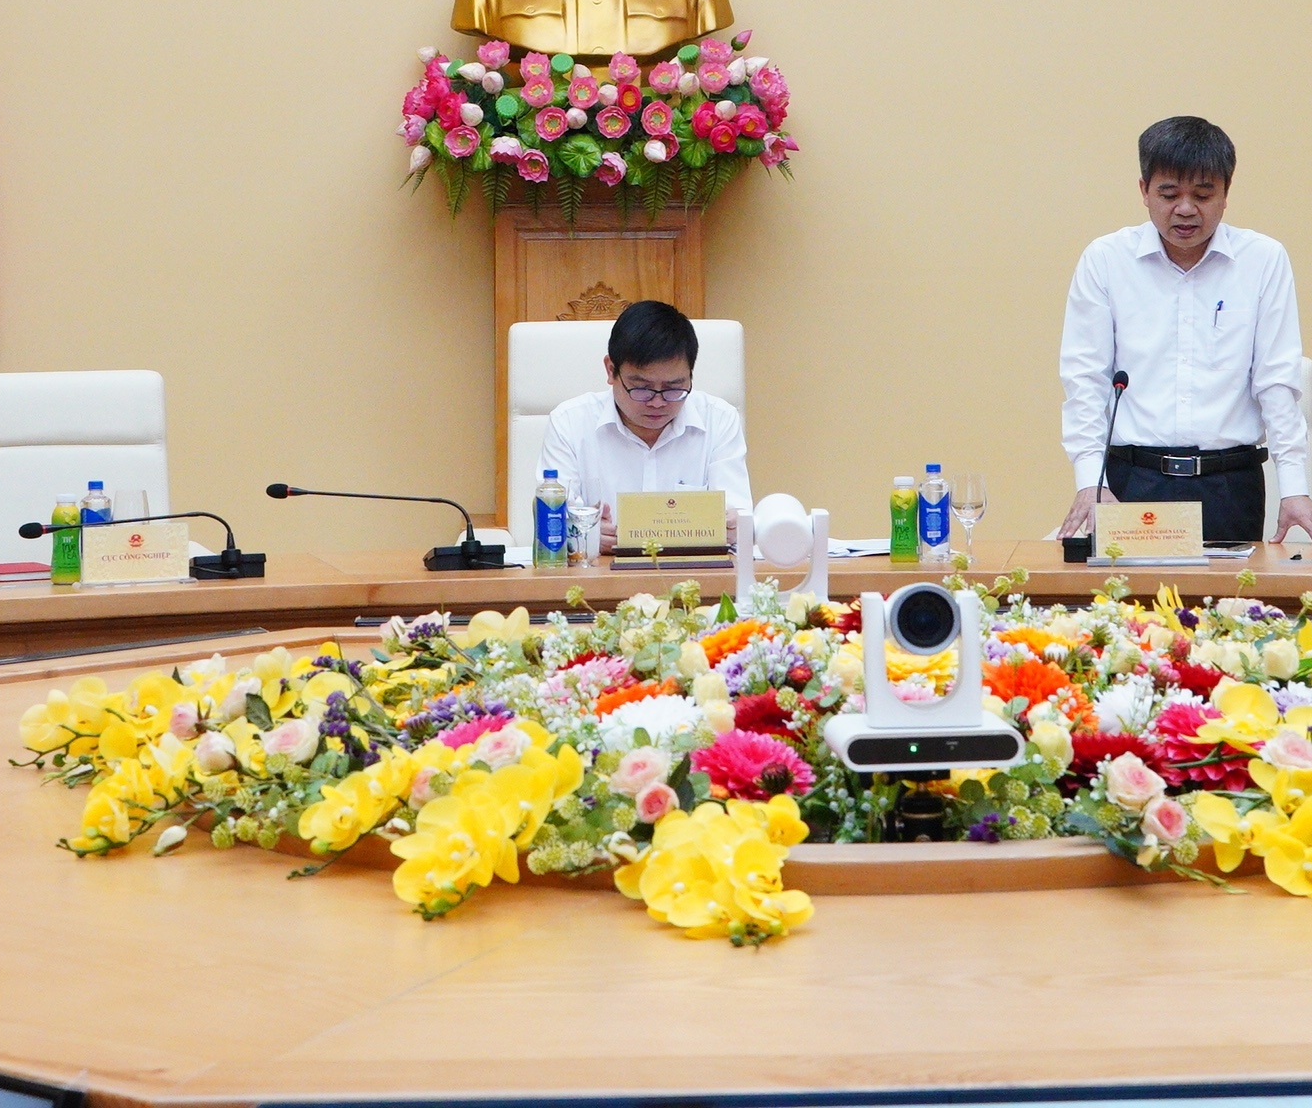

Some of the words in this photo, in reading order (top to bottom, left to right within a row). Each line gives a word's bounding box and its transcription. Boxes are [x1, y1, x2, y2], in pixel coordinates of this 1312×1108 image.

[665, 529, 693, 538] THANH
[101, 554, 118, 563] CỤC
[119, 552, 141, 561] CÔNG
[142, 551, 171, 560] NGHIỆP
